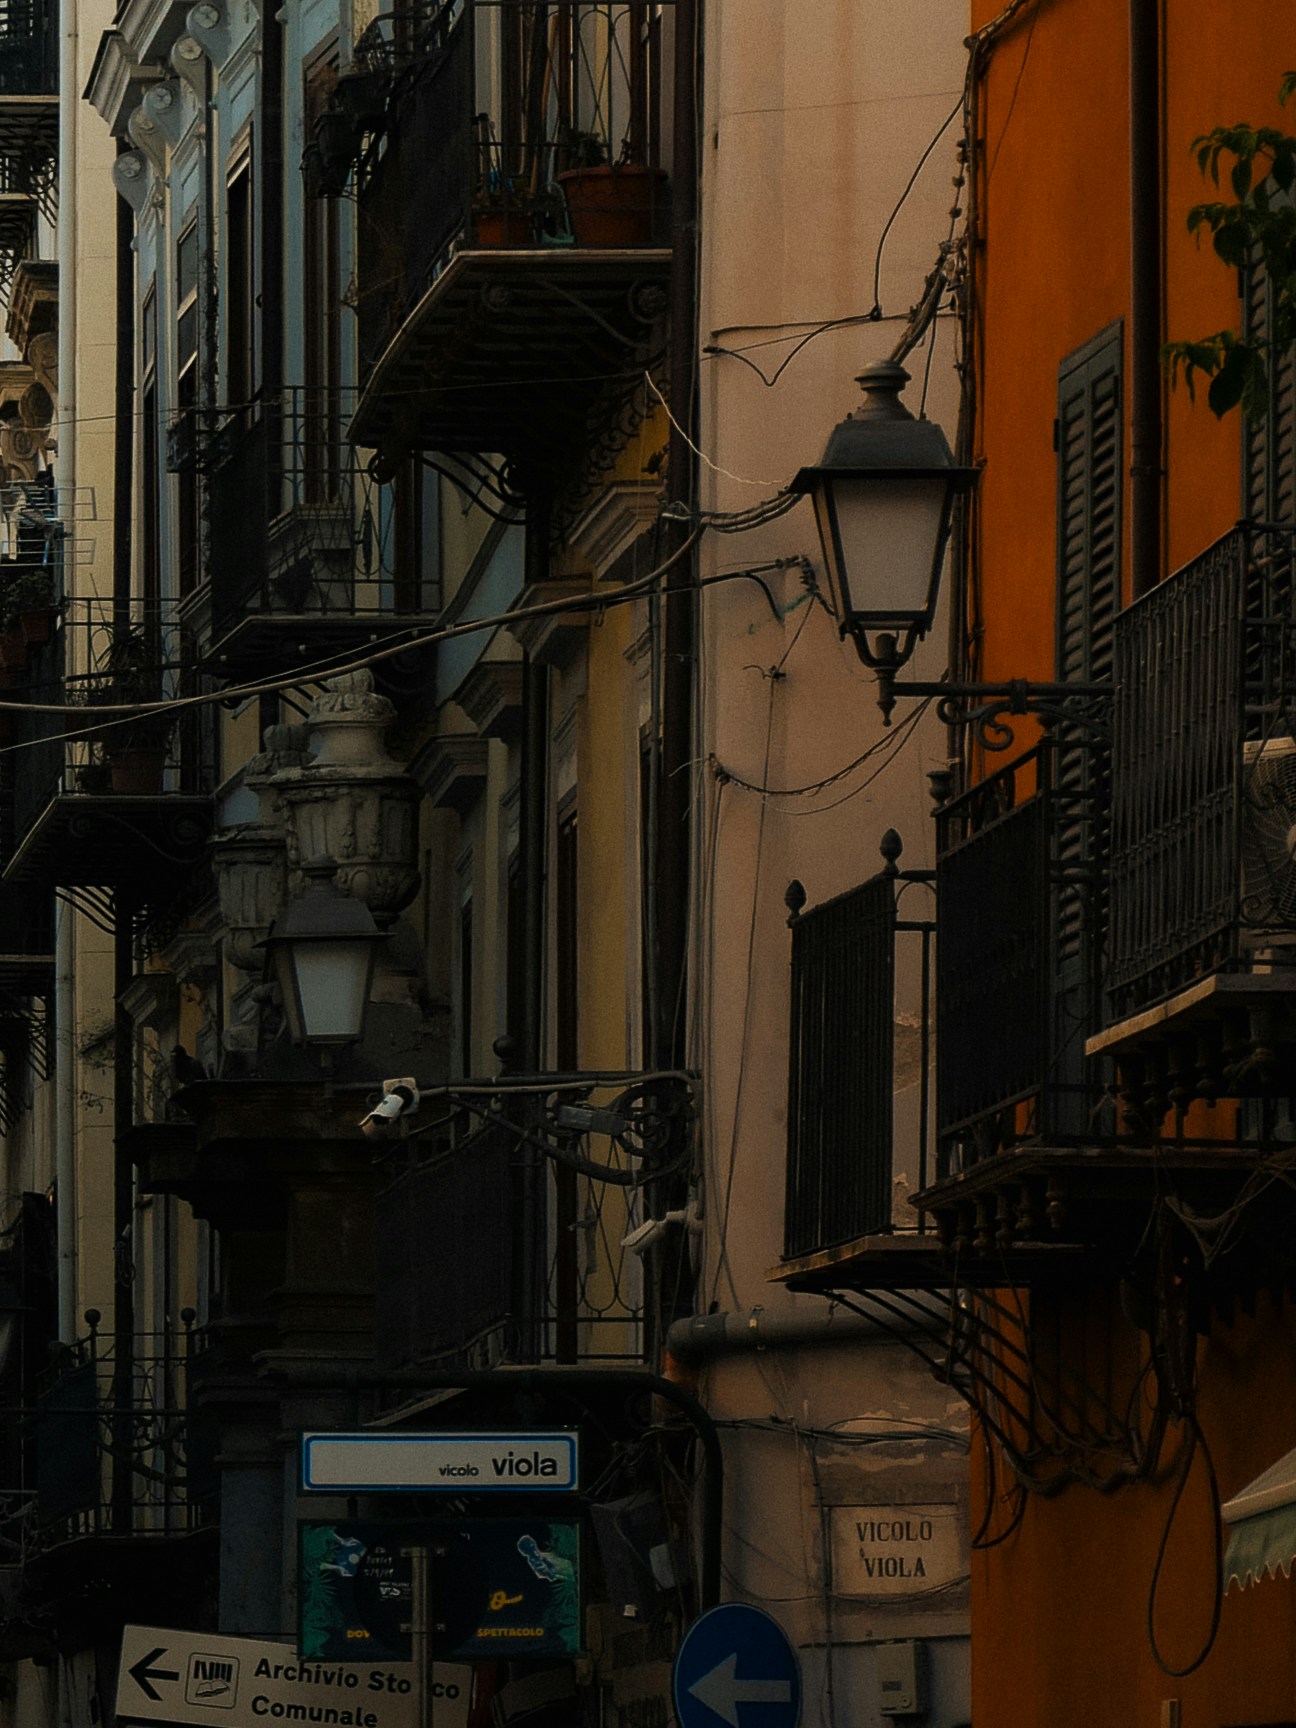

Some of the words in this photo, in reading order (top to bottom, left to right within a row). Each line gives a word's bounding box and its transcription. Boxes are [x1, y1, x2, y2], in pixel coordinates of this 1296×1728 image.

[439, 1464, 479, 1477] vicolo
[492, 1452, 557, 1477] viola
[856, 1520, 932, 1542] VICOLO
[864, 1556, 926, 1578] VIOLA
[477, 1628, 545, 1638] SPETTACOLO
[254, 1657, 359, 1689] Archivio
[368, 1670, 460, 1700] Stoco
[251, 1694, 378, 1728] Comunale
